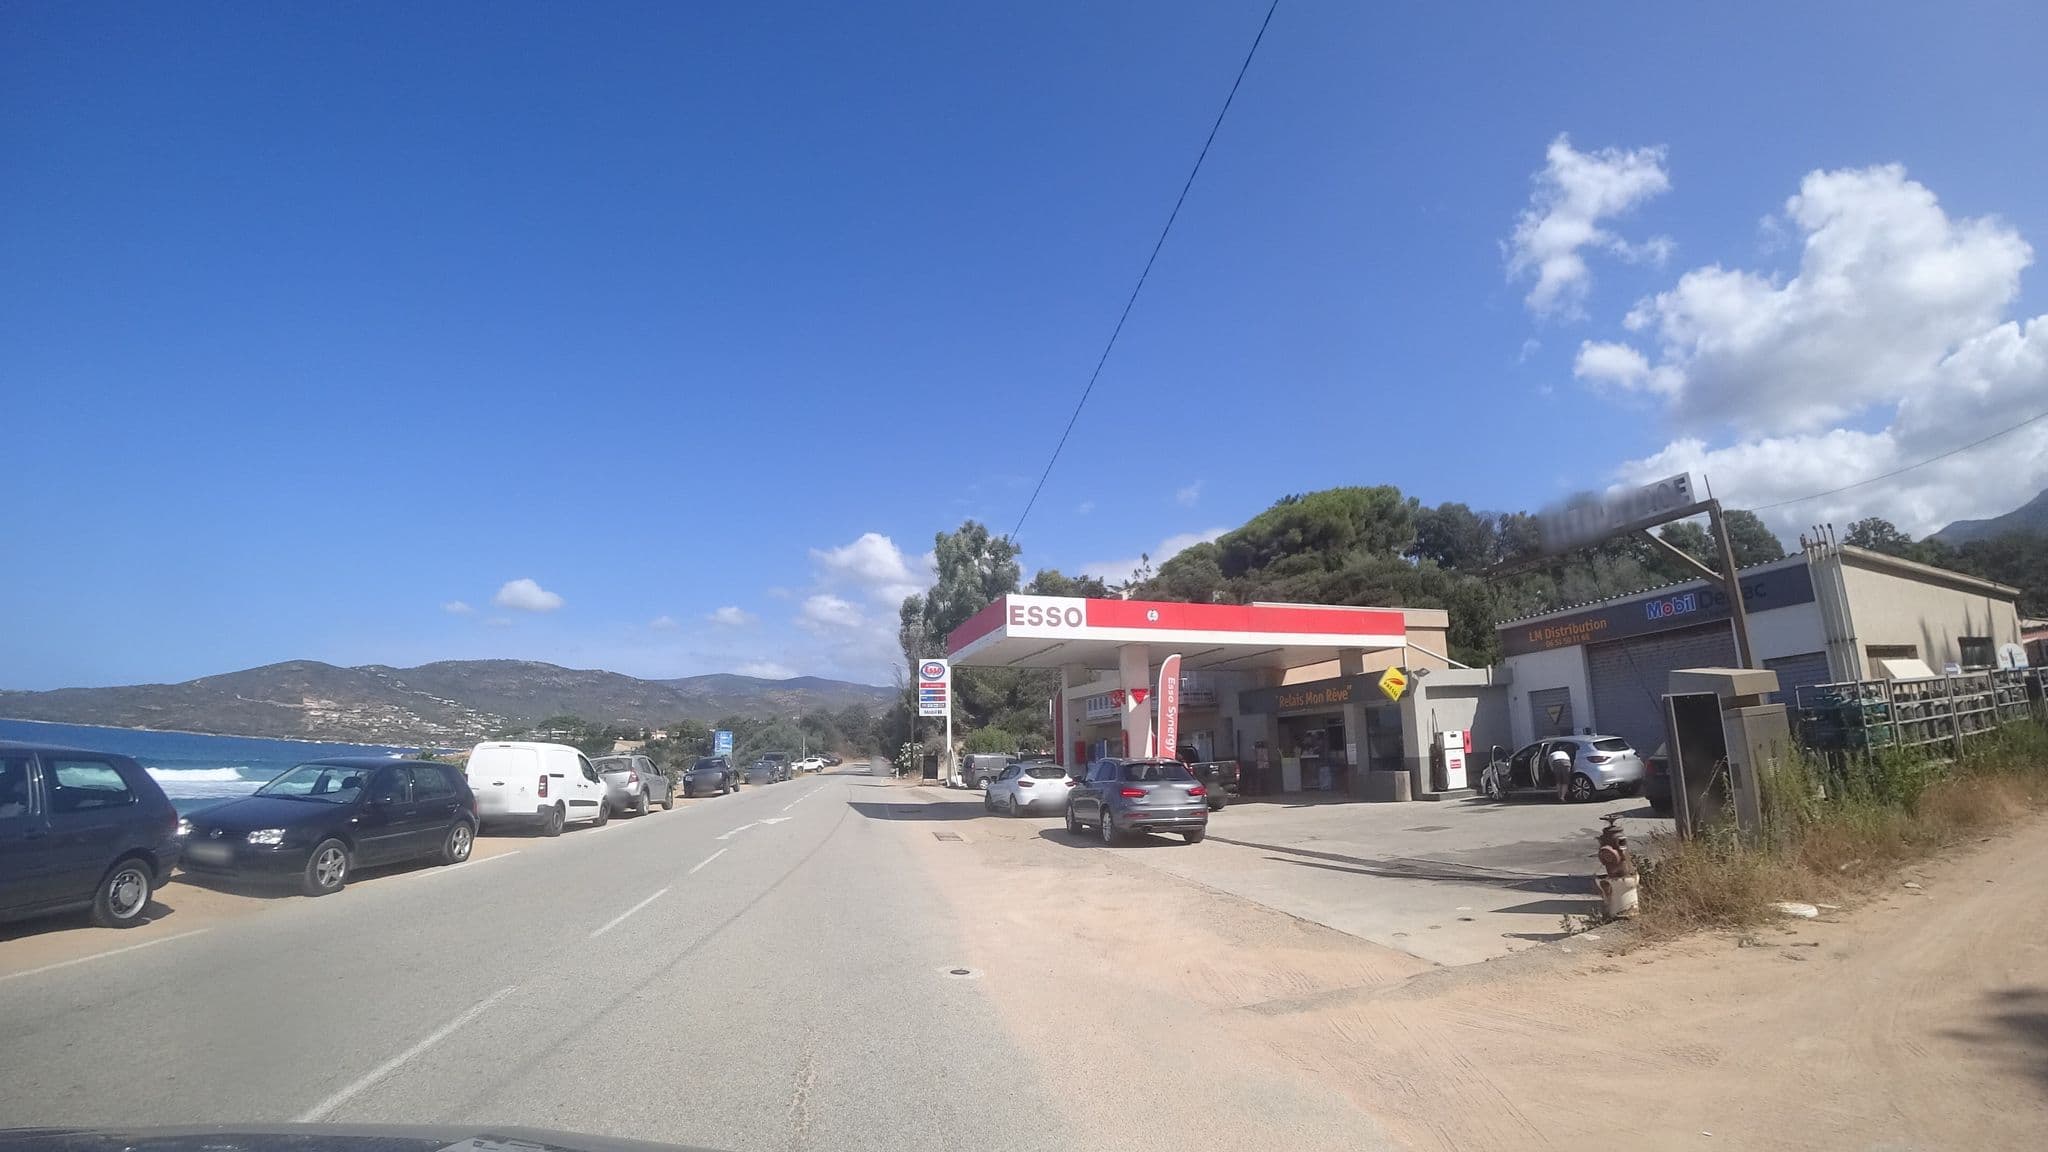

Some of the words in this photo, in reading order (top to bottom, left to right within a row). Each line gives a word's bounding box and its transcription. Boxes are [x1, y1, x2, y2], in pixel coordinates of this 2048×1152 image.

[1646, 593, 1696, 620] Mobil
[1699, 583, 1766, 608] Deac
[1009, 604, 1083, 628] ESSO
[1528, 629, 1543, 642] LM
[1544, 619, 1608, 640] Distribution
[1167, 677, 1176, 702] Esso
[1305, 691, 1324, 705] Mon
[1165, 705, 1177, 753] Synergy
